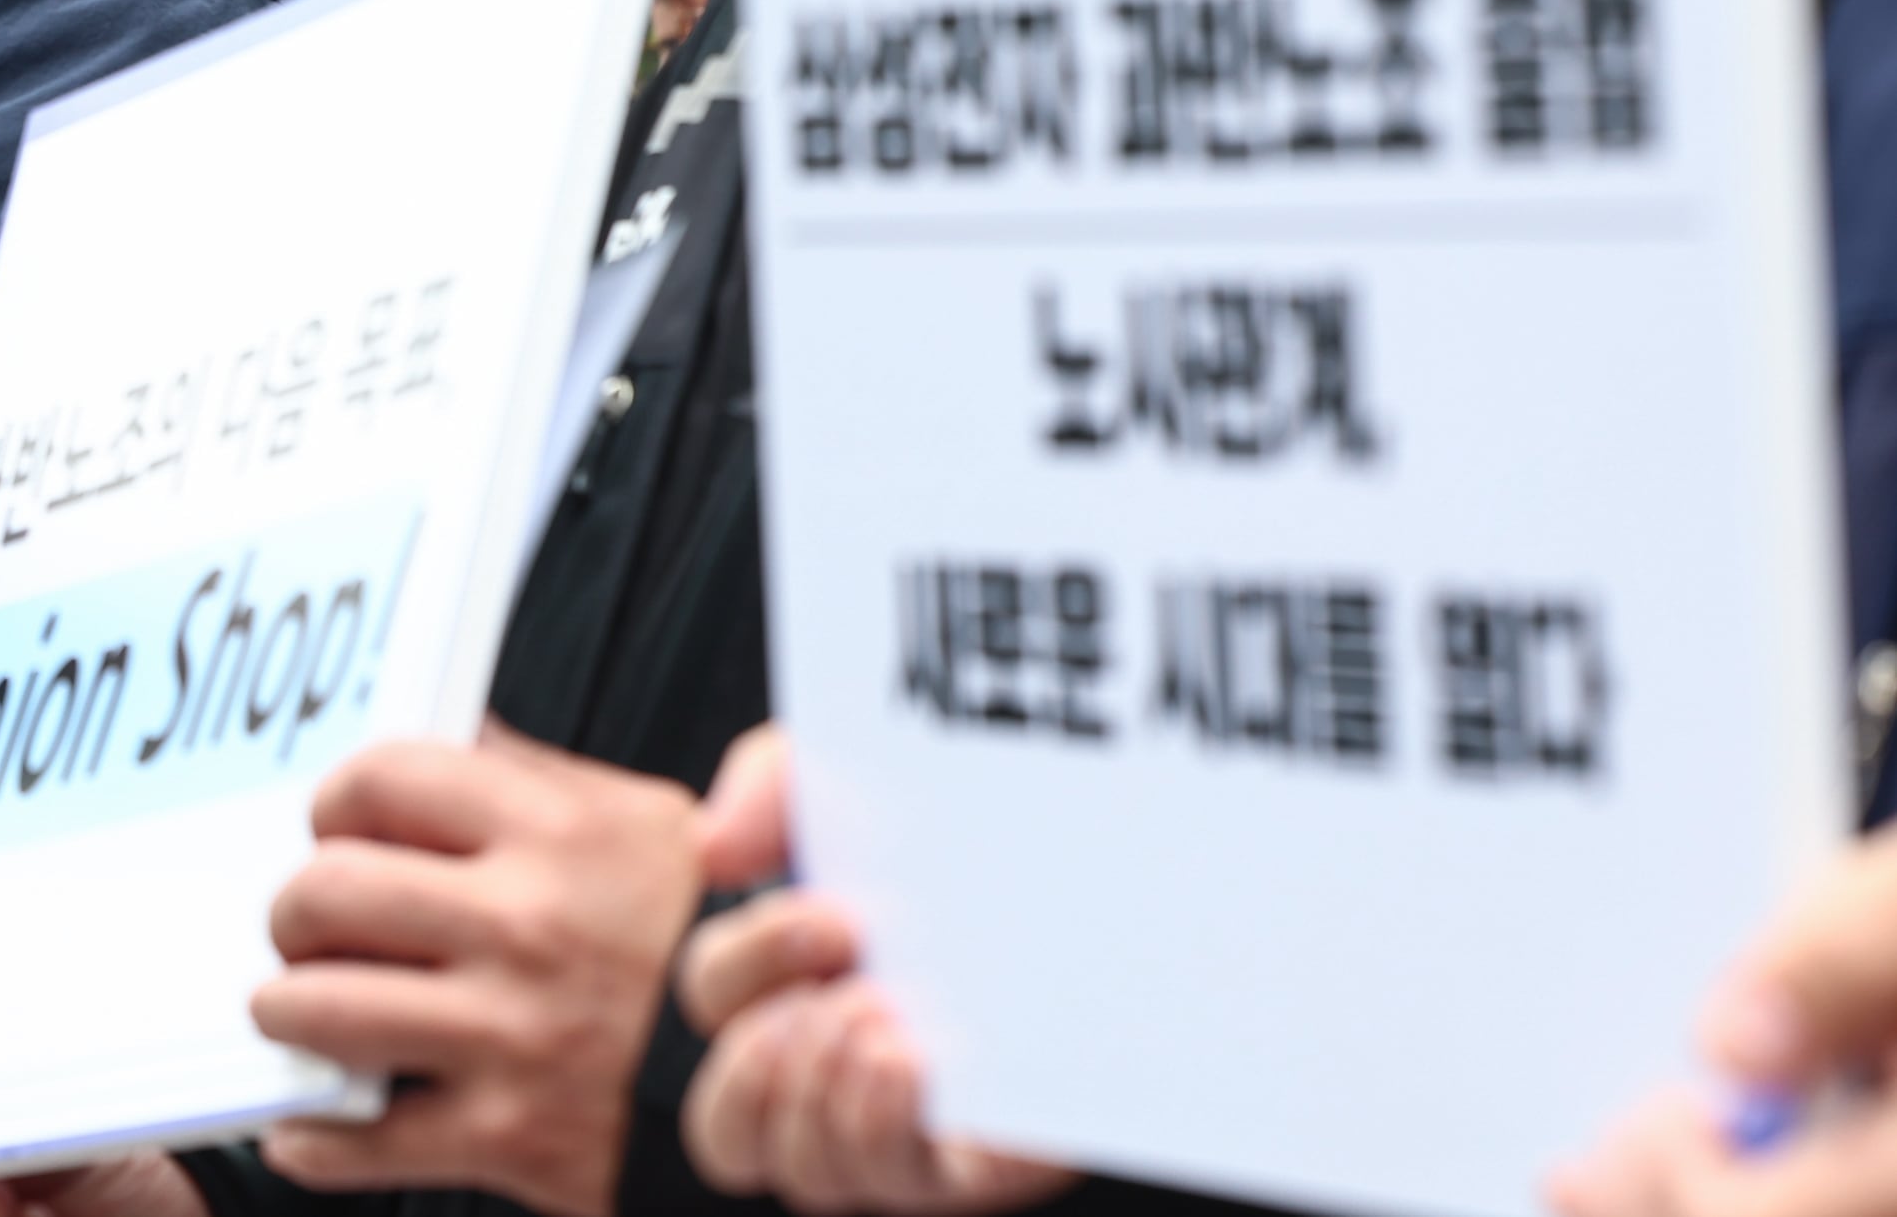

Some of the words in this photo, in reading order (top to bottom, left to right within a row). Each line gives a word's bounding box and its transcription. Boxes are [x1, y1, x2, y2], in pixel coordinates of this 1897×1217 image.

[793, 3, 1079, 175] 삼성전자
[220, 315, 325, 477] 다음
[136, 503, 427, 767] Shop!
[899, 560, 1115, 742] 새로운
[1154, 570, 1390, 768] 시대를
[1435, 587, 1614, 785] 열다
